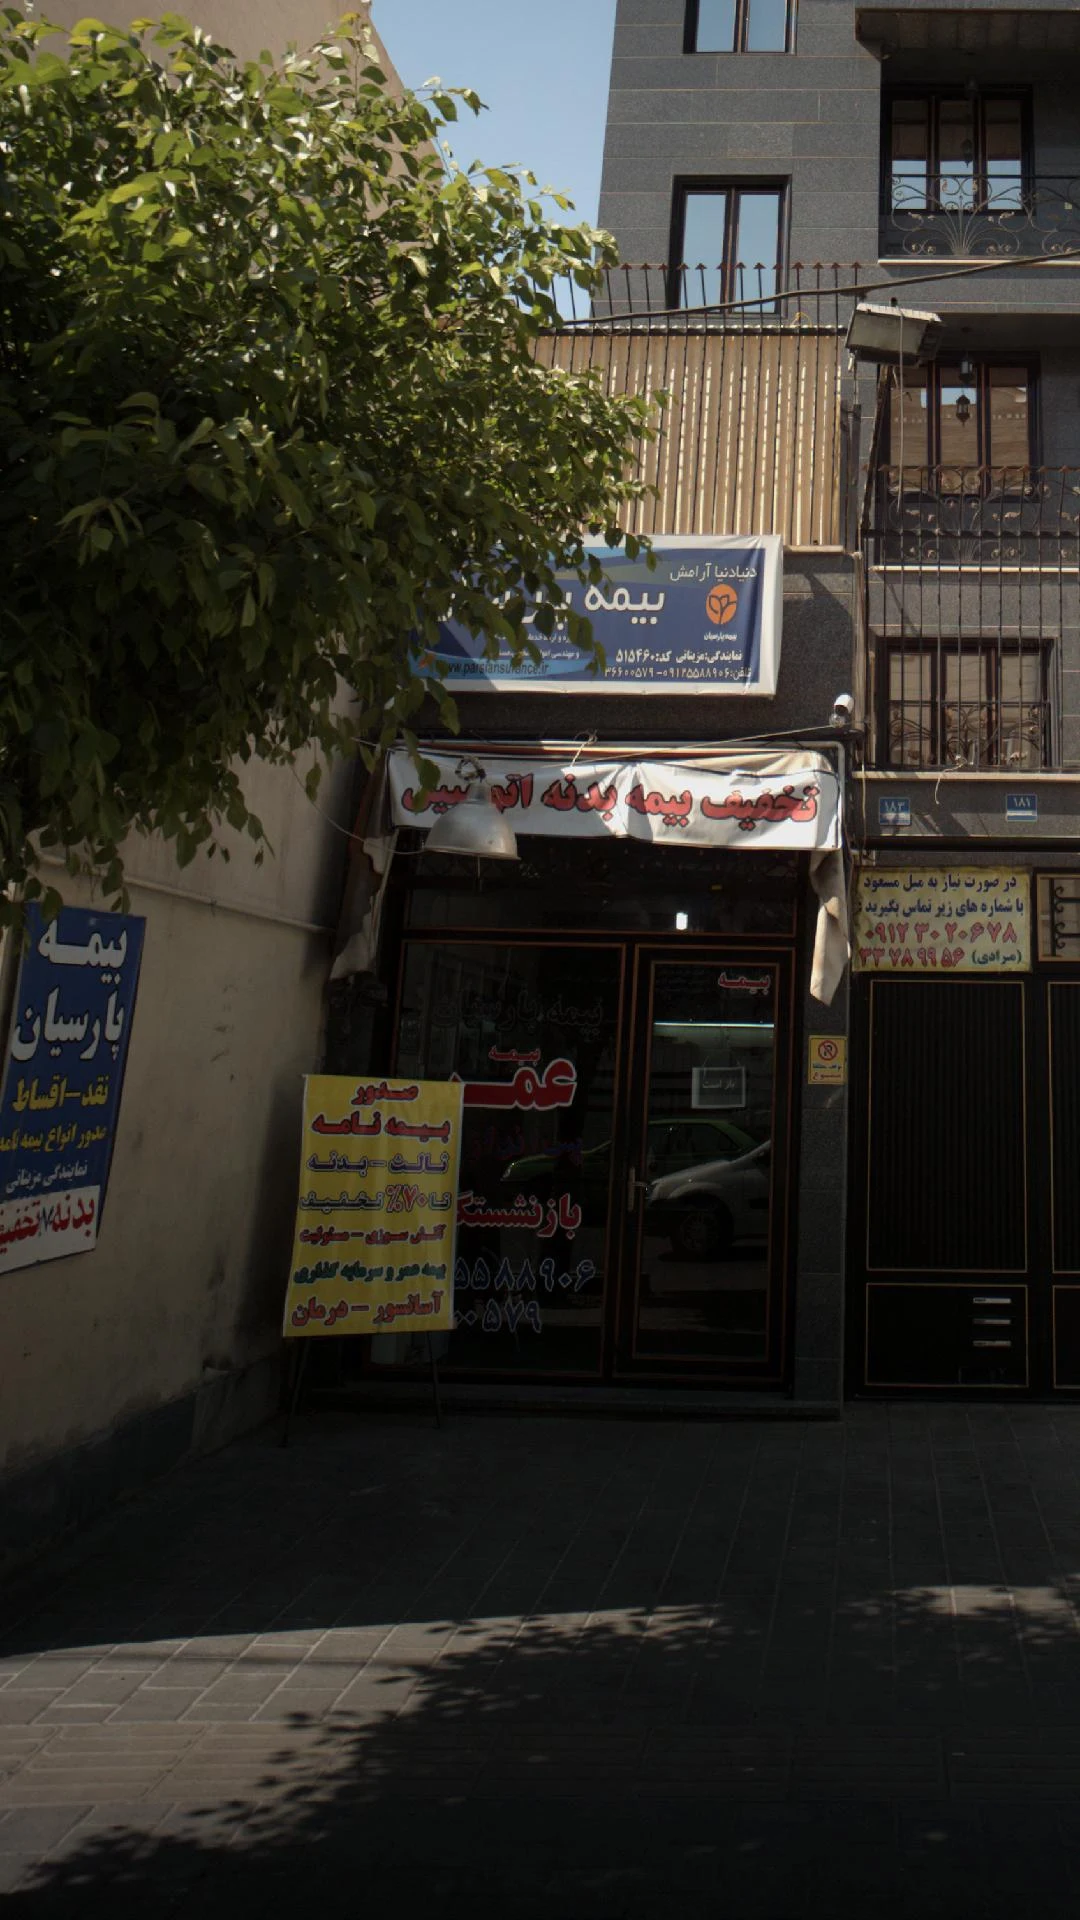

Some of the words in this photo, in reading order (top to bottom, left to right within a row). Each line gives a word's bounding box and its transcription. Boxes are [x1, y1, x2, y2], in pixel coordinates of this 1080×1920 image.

[669, 562, 712, 583] آرامش
[584, 584, 665, 625] بیمه
[541, 773, 619, 821] بدنه
[625, 784, 693, 827] بیمه
[701, 785, 821, 831] تخفیف
[928, 876, 938, 891] به
[942, 873, 961, 892] نیاز
[1003, 875, 1017, 892] در
[902, 899, 932, 917] تماس
[935, 900, 953, 917] زیر
[1016, 897, 1024, 913] با
[38, 920, 128, 985] بیمه
[717, 971, 772, 995] بیمه
[11, 986, 126, 1063] پارسیان
[487, 1044, 542, 1068] بیمه
[351, 1082, 419, 1106] صدور
[312, 1110, 383, 1136] نامه
[384, 1115, 451, 1144] بیمه
[52, 1193, 95, 1237] بدنه
[300, 1191, 385, 1215] تخفیف
